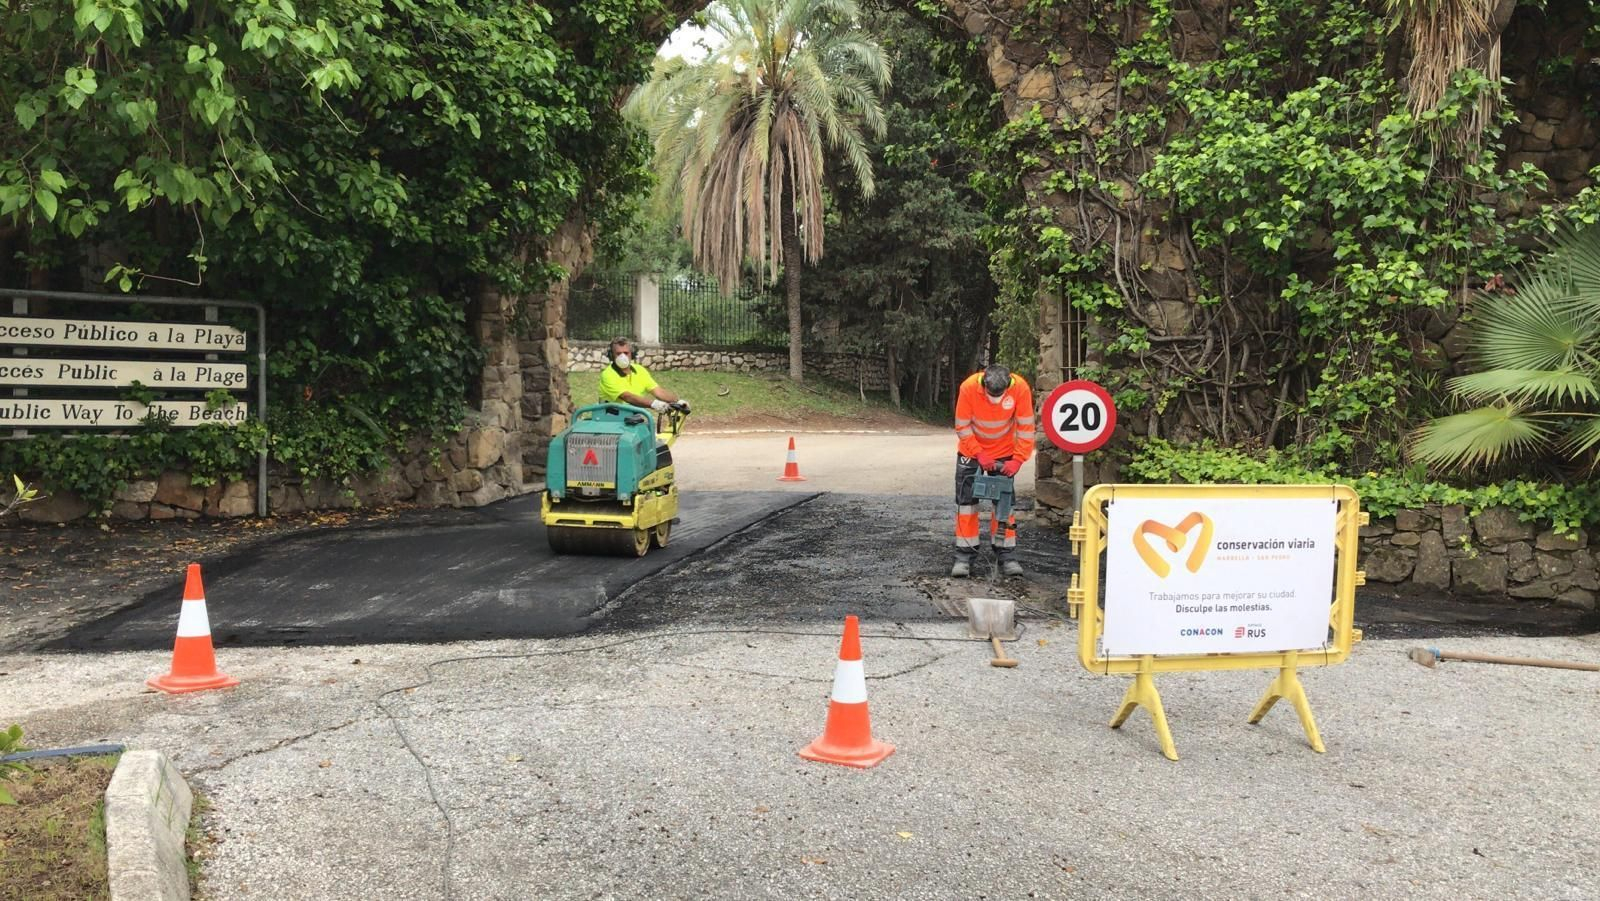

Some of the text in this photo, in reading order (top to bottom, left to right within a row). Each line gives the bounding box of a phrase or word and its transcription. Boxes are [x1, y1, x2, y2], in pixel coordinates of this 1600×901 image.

[64, 323, 138, 341] Público
[148, 331, 158, 342] a
[168, 328, 185, 343] la
[194, 329, 245, 349] Playa
[58, 363, 118, 380] Public
[170, 367, 186, 381] la
[195, 367, 245, 386] Plage
[0, 404, 245, 424] ublic Way To The Beach
[1059, 402, 1101, 432] 20
[1216, 537, 1316, 550] conservación viaria
[1149, 591, 1200, 604] Trabajamos
[1201, 593, 1221, 604] para
[1223, 591, 1255, 603] mejorar
[1175, 603, 1273, 614] Disculpe las molestias.
[1180, 628, 1224, 637] CONACON
[1247, 628, 1267, 638] RUS
